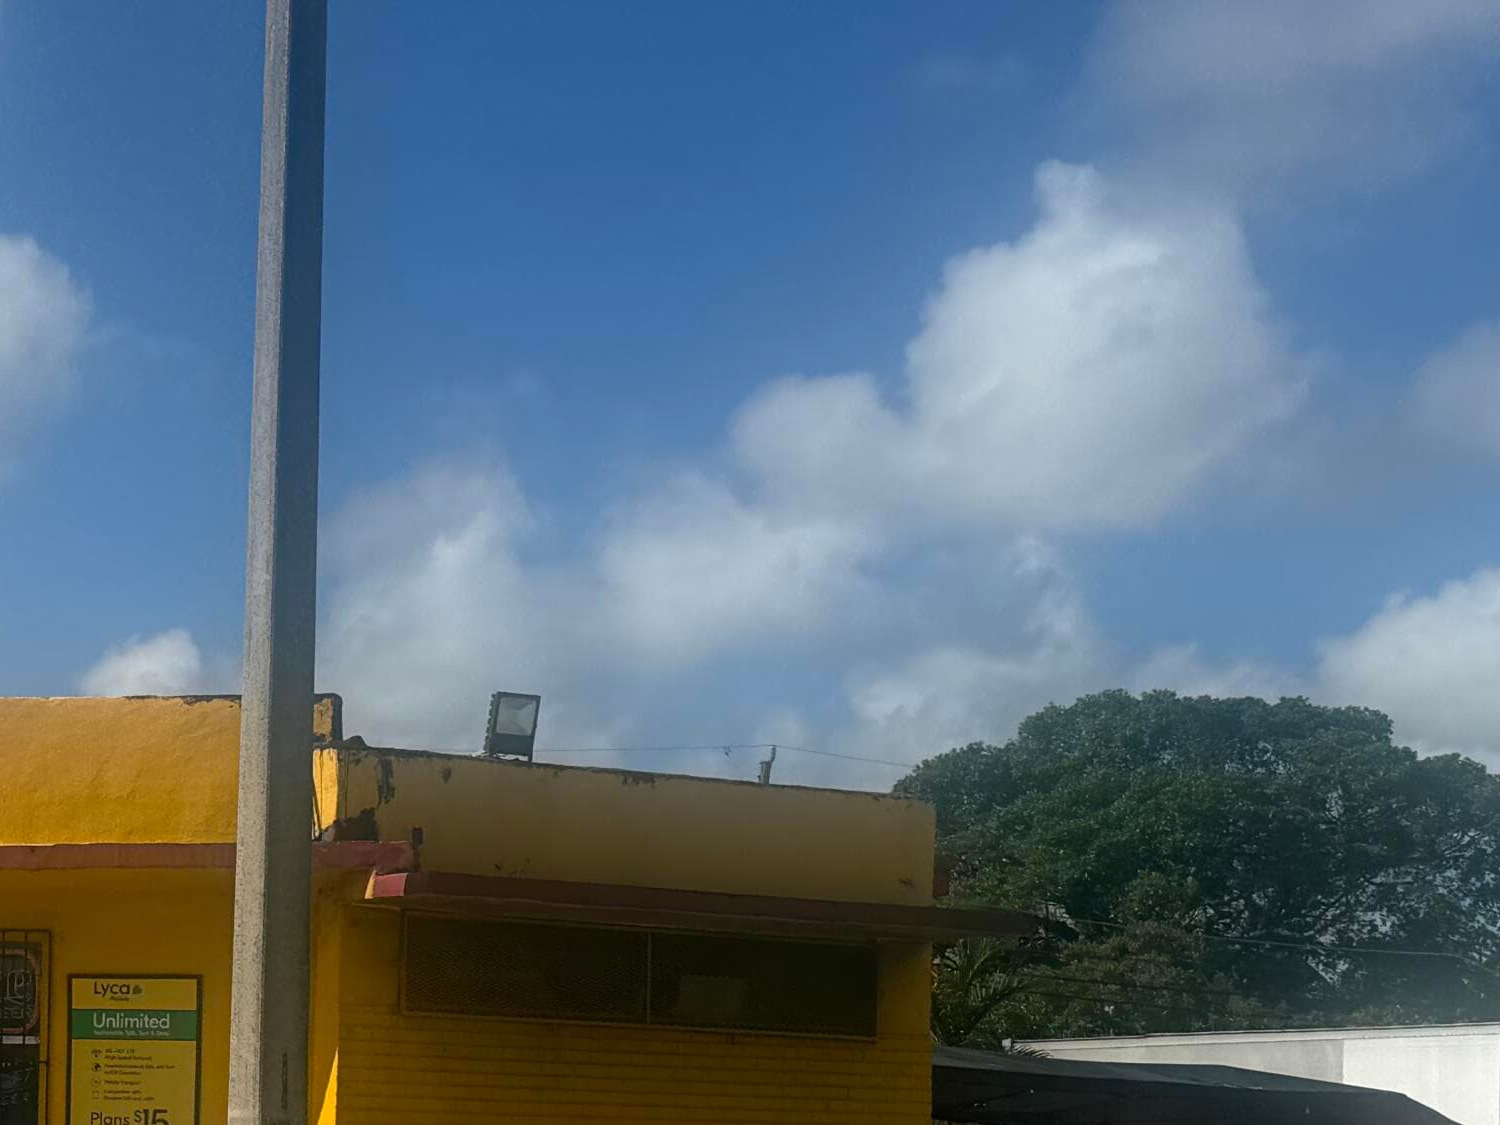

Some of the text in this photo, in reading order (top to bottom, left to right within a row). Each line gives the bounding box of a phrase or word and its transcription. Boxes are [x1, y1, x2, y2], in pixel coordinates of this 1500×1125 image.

[93, 981, 130, 997] Lyca
[92, 1012, 170, 1030] Unlimited
[90, 1111, 130, 1125] Plans
